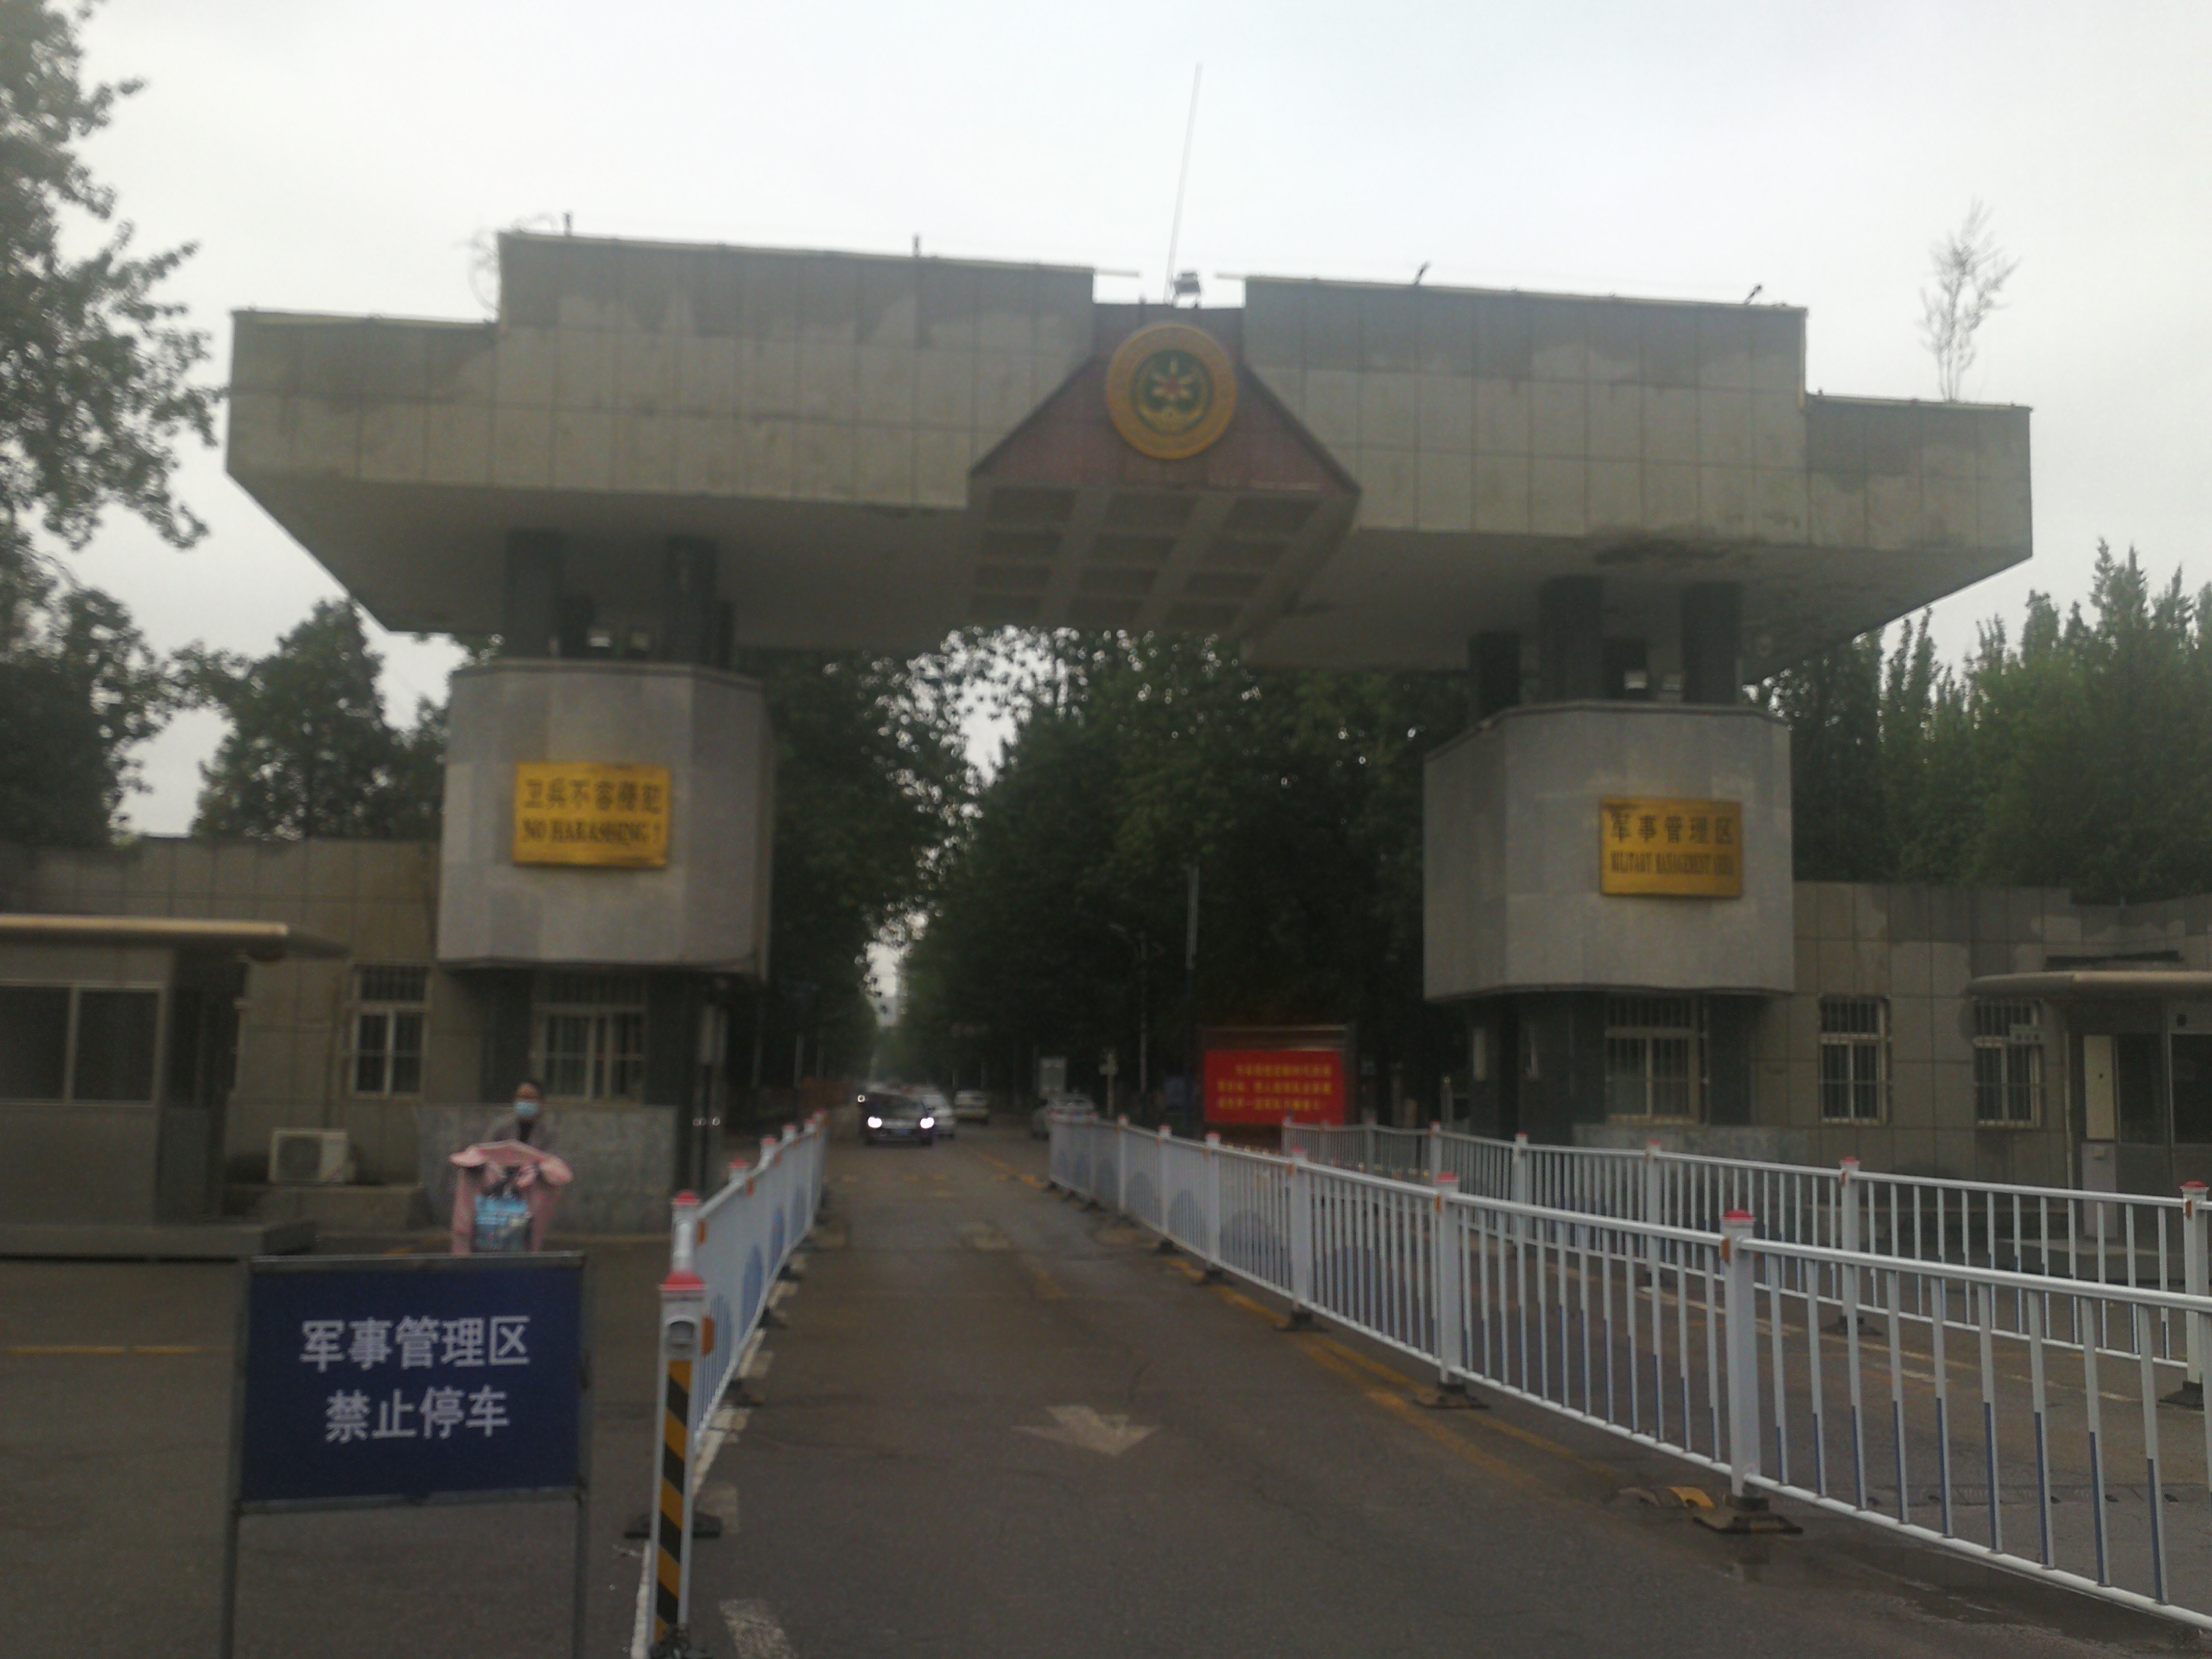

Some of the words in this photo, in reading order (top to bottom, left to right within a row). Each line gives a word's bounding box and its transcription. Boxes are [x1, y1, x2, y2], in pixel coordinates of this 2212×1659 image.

[1611, 812, 1733, 844] 军事管理区
[299, 1316, 531, 1374] 军事管理区
[325, 1384, 511, 1444] 禁止停车
